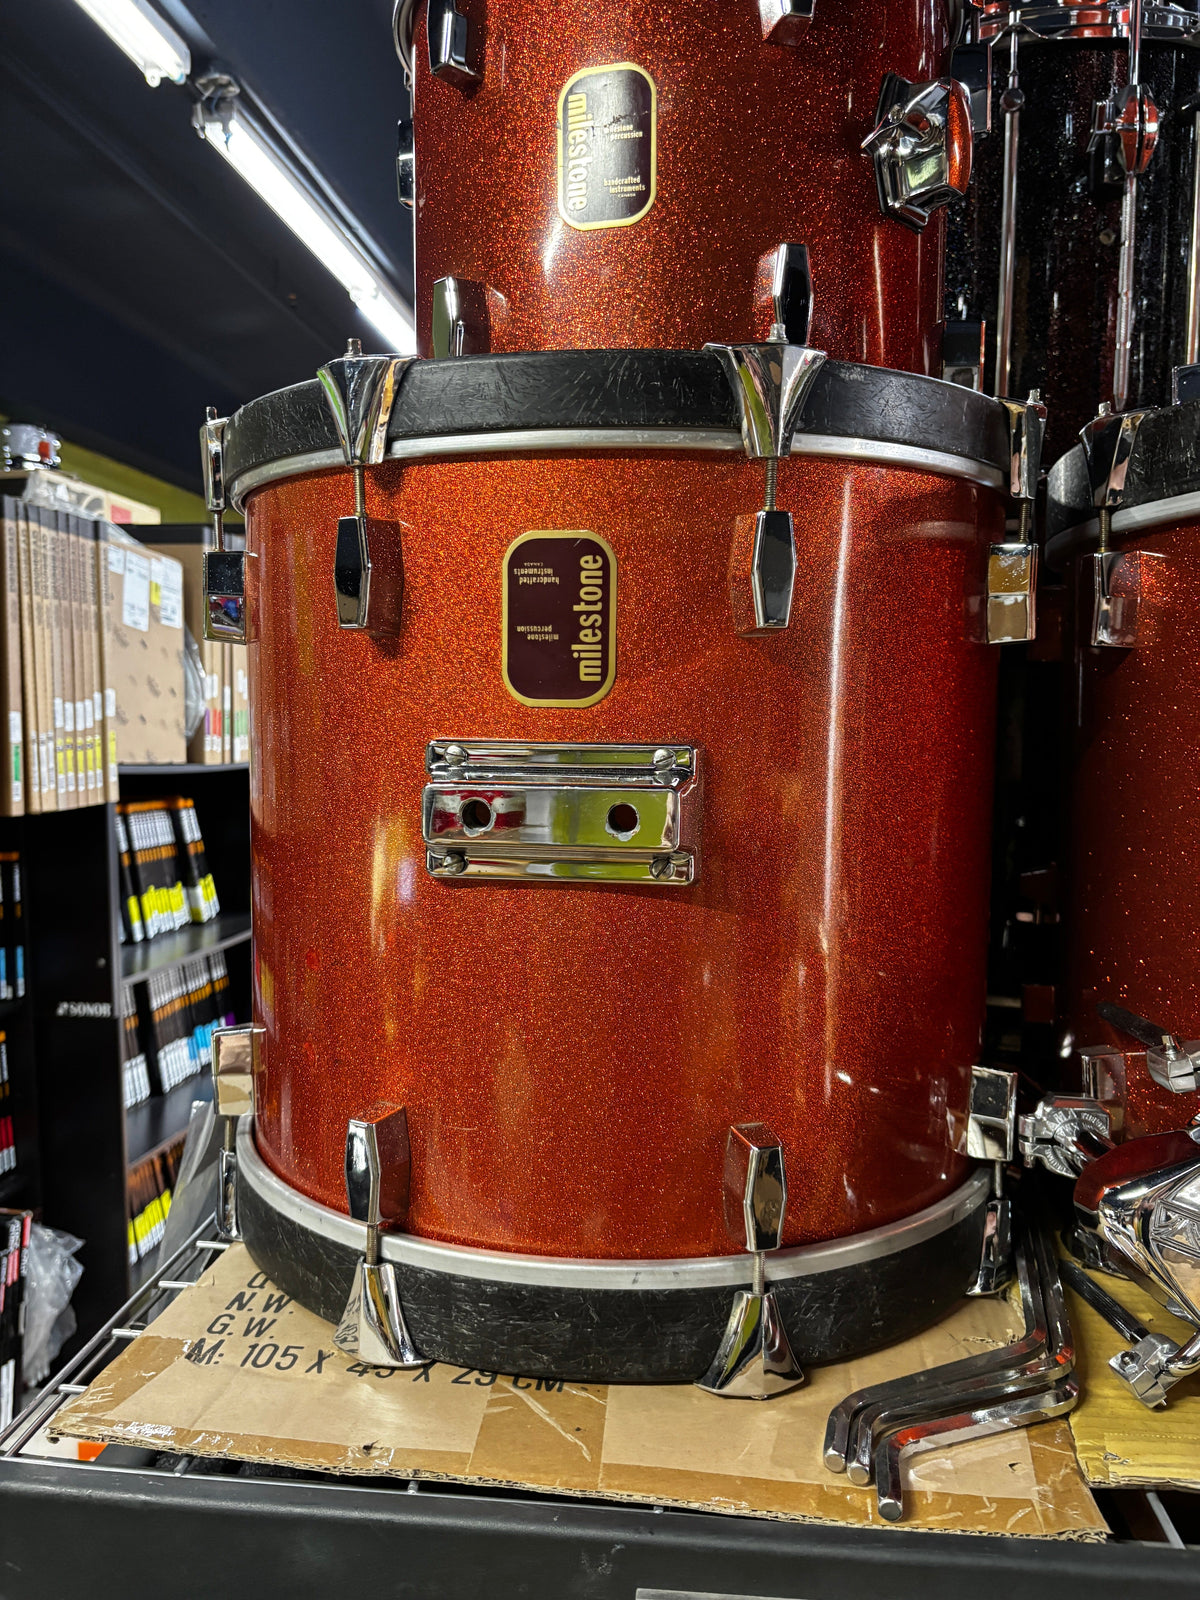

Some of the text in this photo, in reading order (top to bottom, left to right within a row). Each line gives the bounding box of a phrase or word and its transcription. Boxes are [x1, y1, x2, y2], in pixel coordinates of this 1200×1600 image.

[568, 93, 593, 212] milestone
[603, 175, 641, 187] handcrafted
[609, 182, 646, 194] instruments
[513, 568, 554, 576] instruments
[519, 576, 560, 585] handcrafted
[571, 554, 603, 682] milestone
[516, 625, 553, 633] percussion
[527, 633, 559, 641] milestone
[69, 1001, 112, 1018] SONOR
[206, 1313, 277, 1339] G.W.
[240, 1342, 304, 1371] 105
